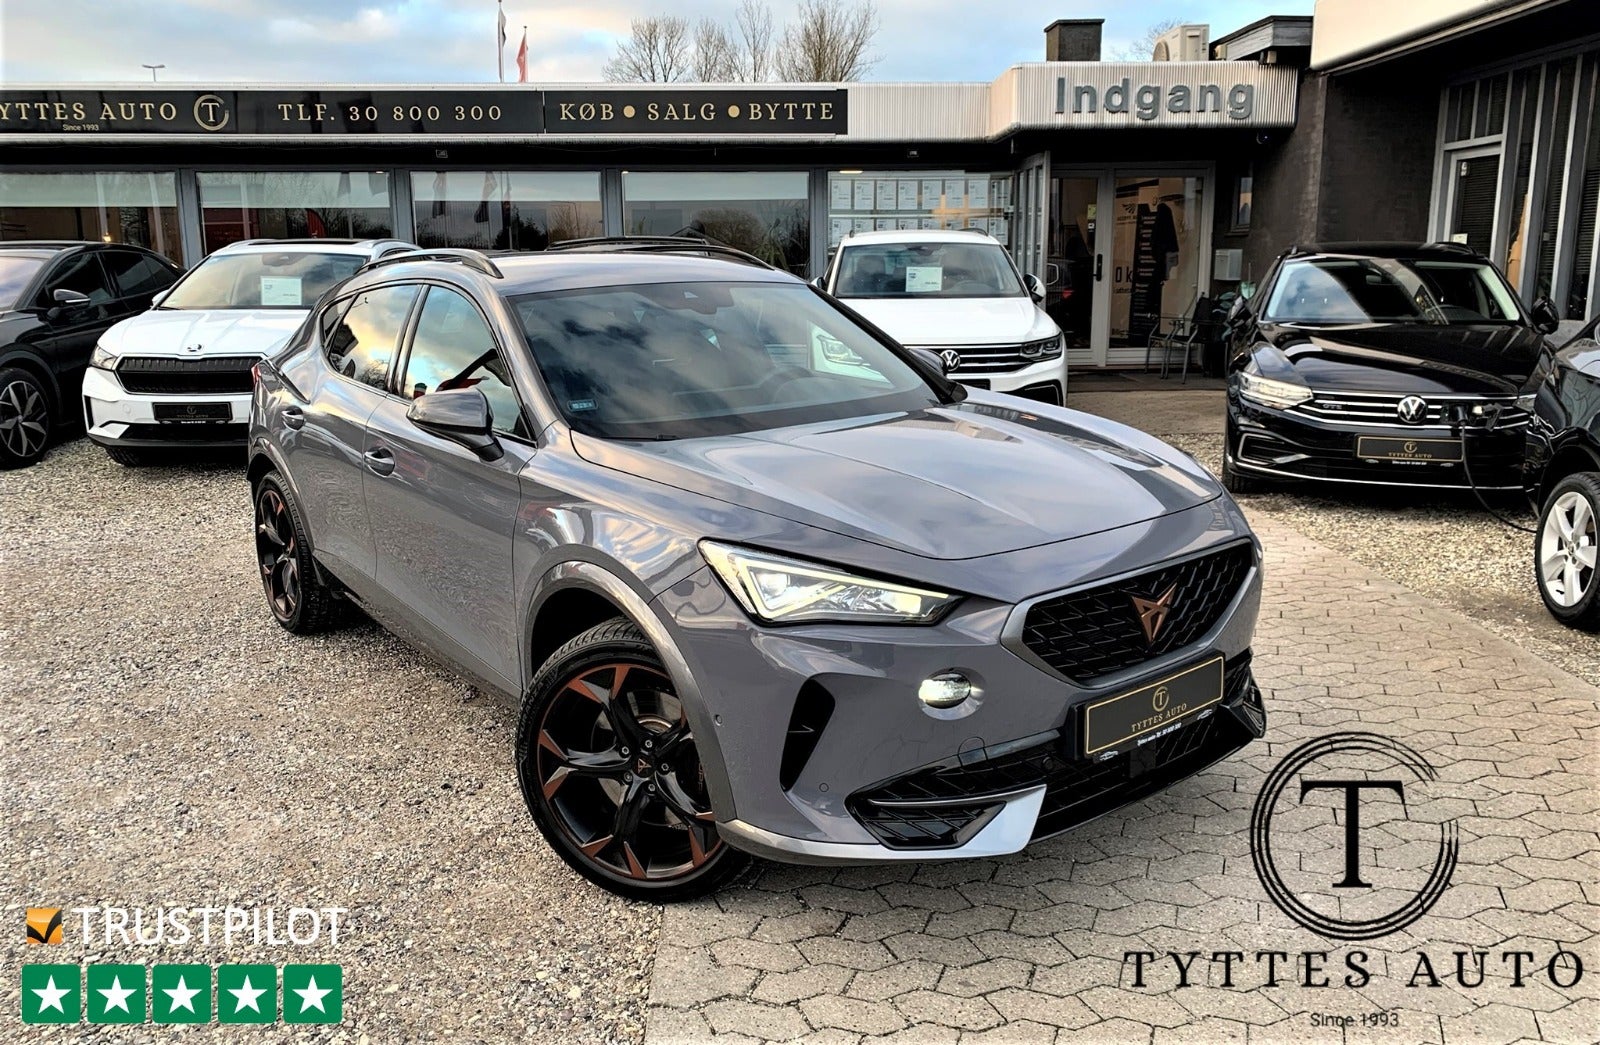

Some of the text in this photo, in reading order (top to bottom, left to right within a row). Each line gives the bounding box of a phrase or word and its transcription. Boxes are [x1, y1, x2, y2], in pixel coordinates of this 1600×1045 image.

[1055, 77, 1254, 121] Indgang
[99, 102, 177, 121] AUTO
[278, 103, 502, 121] TLF. 30 800 300
[559, 102, 834, 121] KØB SALG BYTTE
[62, 123, 99, 131] Since 1993
[1131, 713, 1163, 732] TYTTES
[1165, 702, 1187, 719] AUTO
